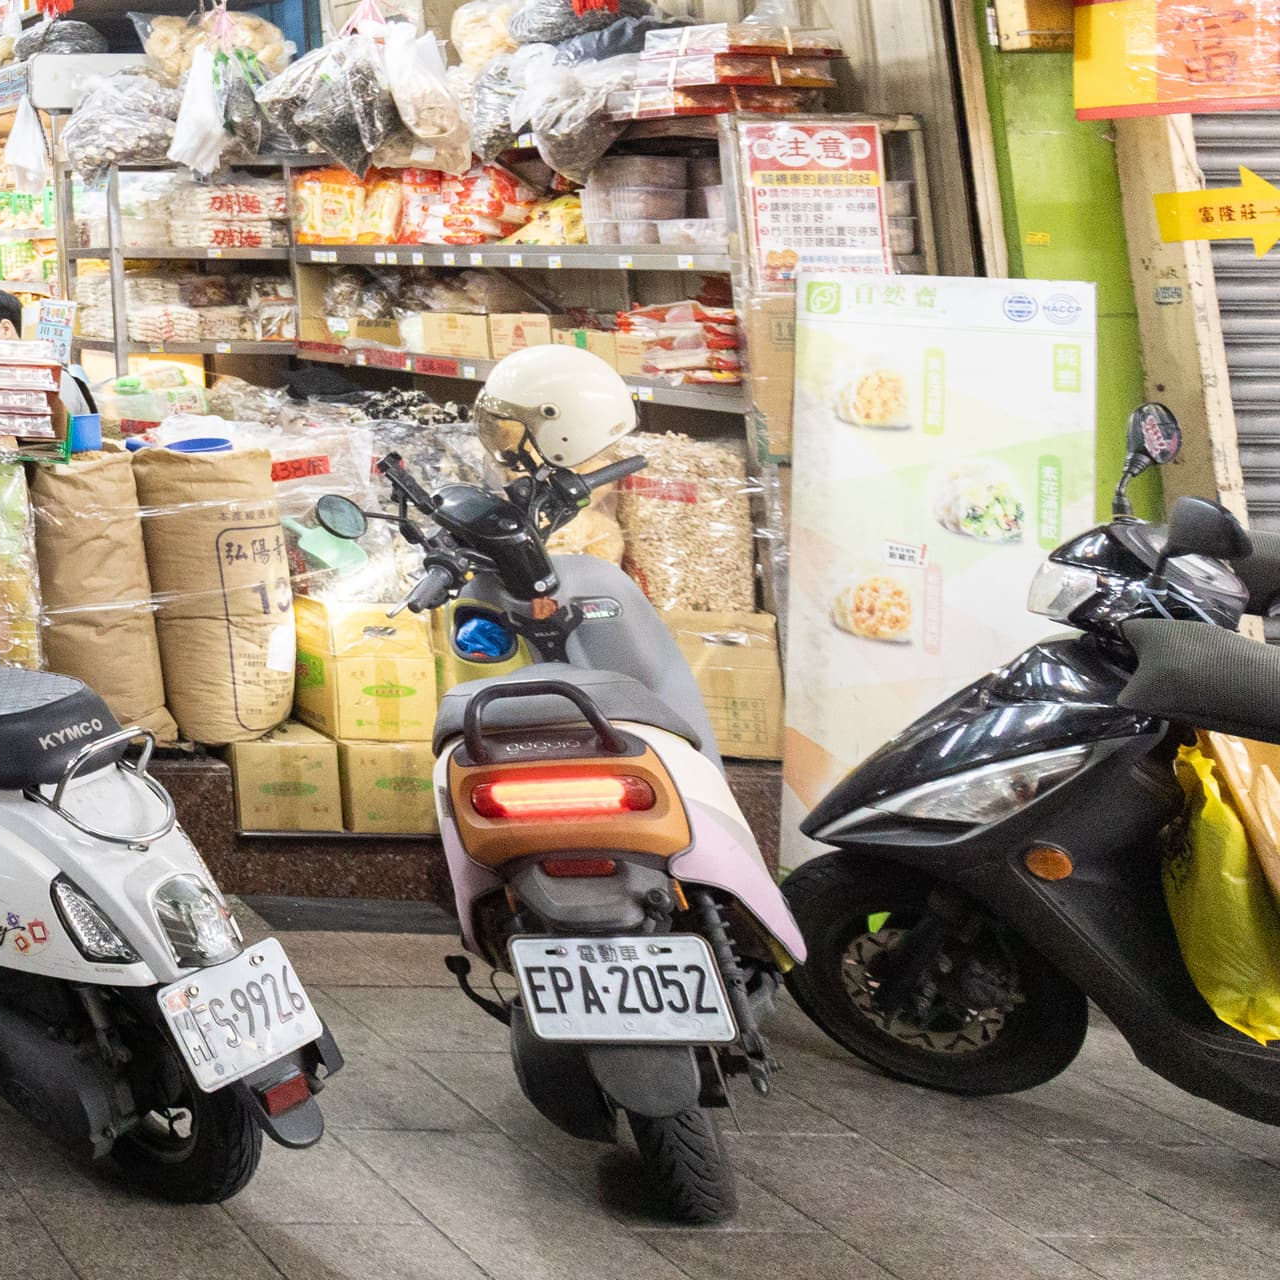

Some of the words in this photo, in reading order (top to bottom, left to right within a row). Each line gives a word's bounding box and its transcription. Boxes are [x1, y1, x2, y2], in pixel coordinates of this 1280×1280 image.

[39, 717, 104, 751] KYMCO
[576, 943, 641, 964] 電動車
